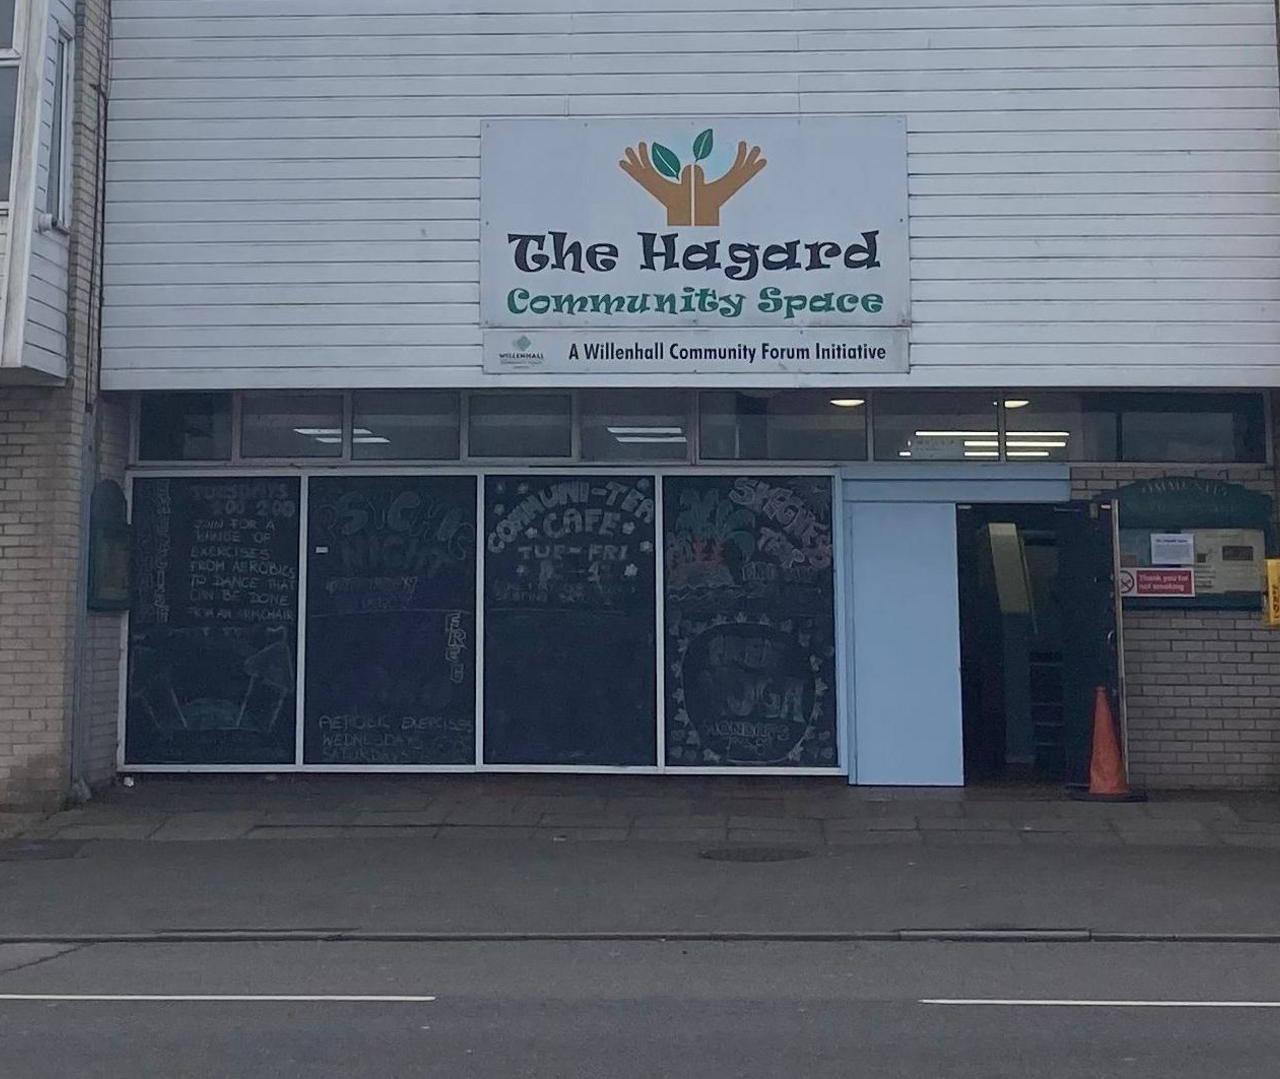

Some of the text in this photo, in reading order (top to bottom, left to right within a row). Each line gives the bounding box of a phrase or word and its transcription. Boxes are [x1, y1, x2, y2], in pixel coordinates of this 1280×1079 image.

[507, 230, 881, 281] The Hagard
[507, 286, 884, 318] Community Space
[568, 342, 886, 364] A Willenhall Community Forum Initiative
[543, 508, 621, 539] CAFE
[212, 575, 260, 589] DANCE
[1139, 574, 1162, 582] Thank
[1163, 575, 1176, 583] you
[1153, 583, 1185, 591] smoking
[248, 592, 290, 606] DONE
